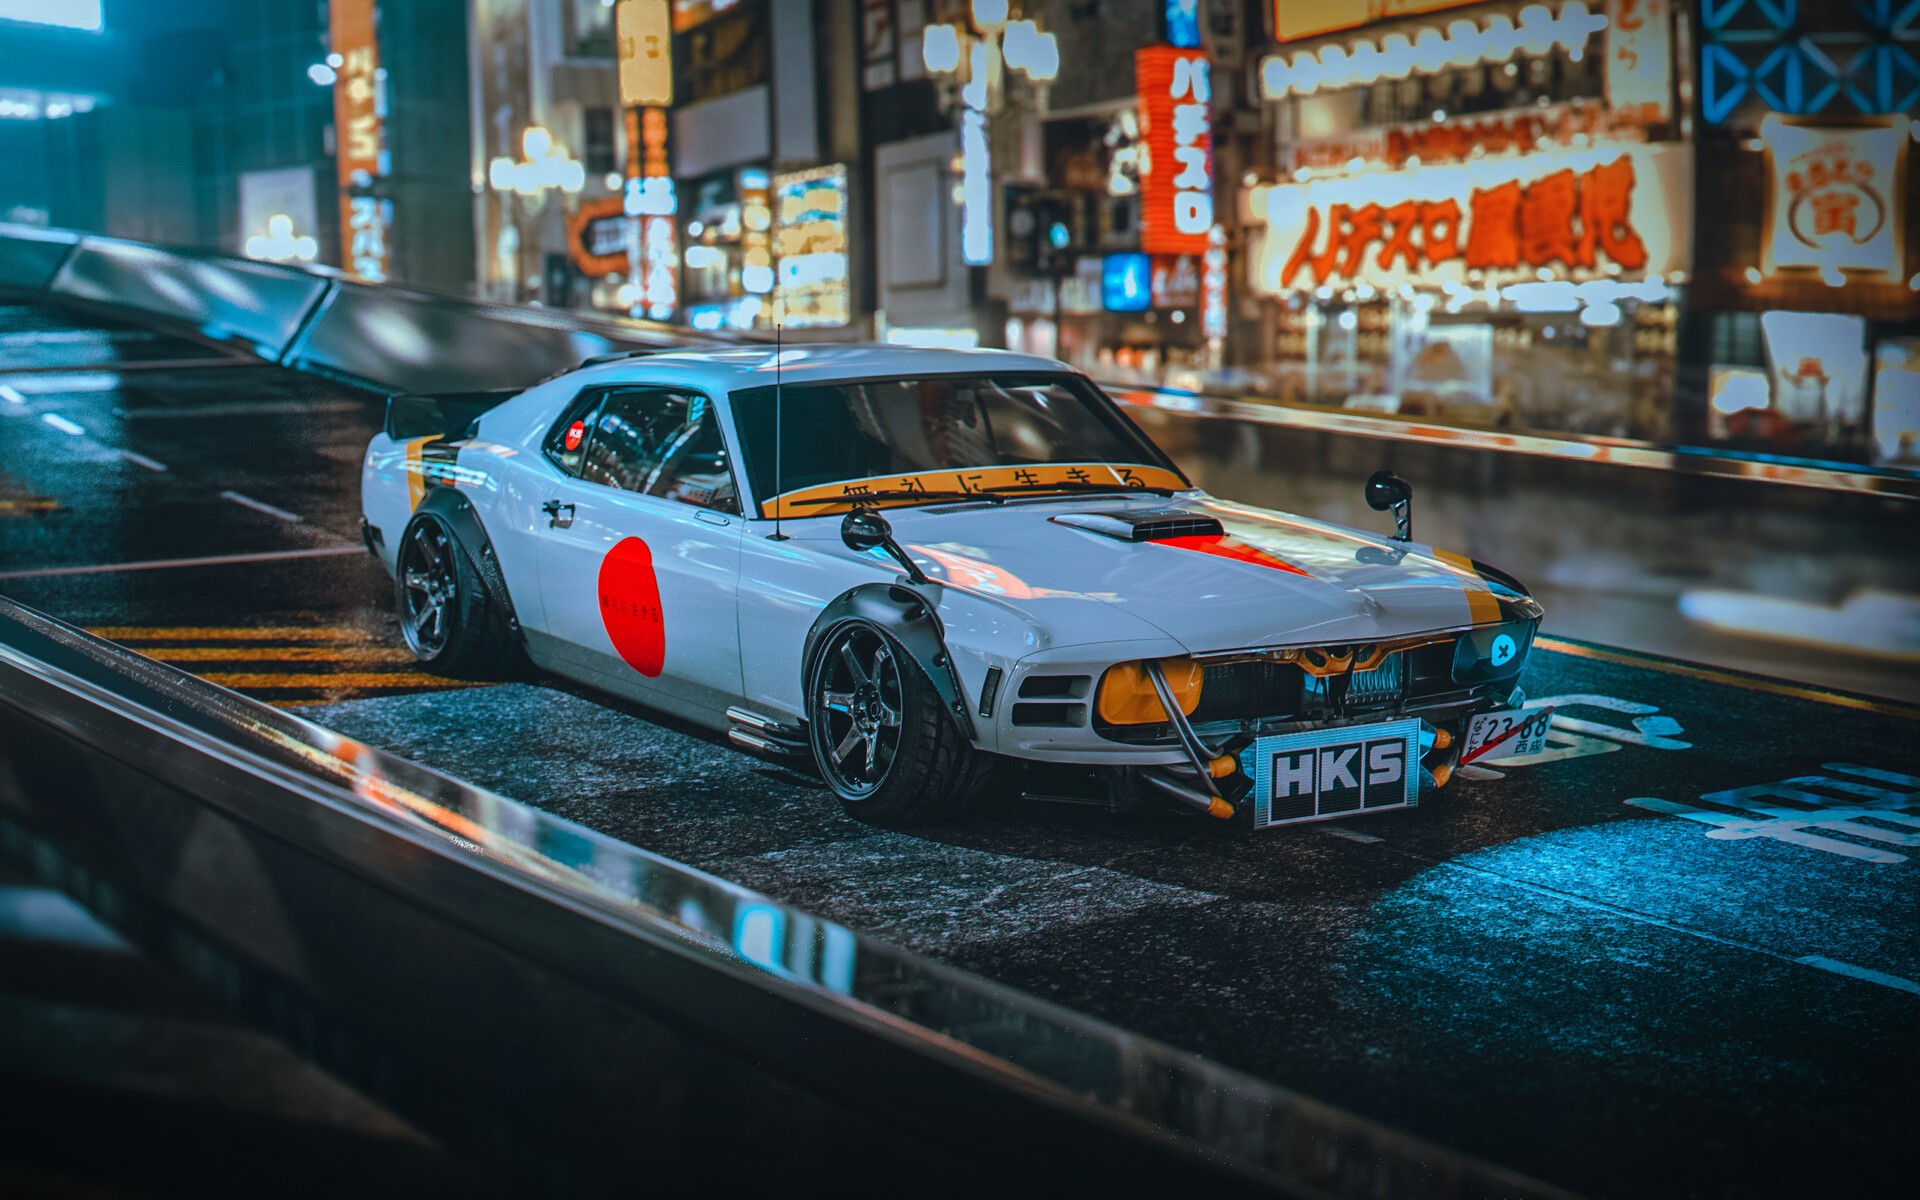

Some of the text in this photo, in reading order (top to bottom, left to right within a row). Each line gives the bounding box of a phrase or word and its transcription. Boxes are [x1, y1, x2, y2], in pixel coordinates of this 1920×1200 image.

[1482, 711, 1549, 745] 23-88
[1515, 740, 1542, 754] 西成
[1275, 742, 1403, 798] HKS
